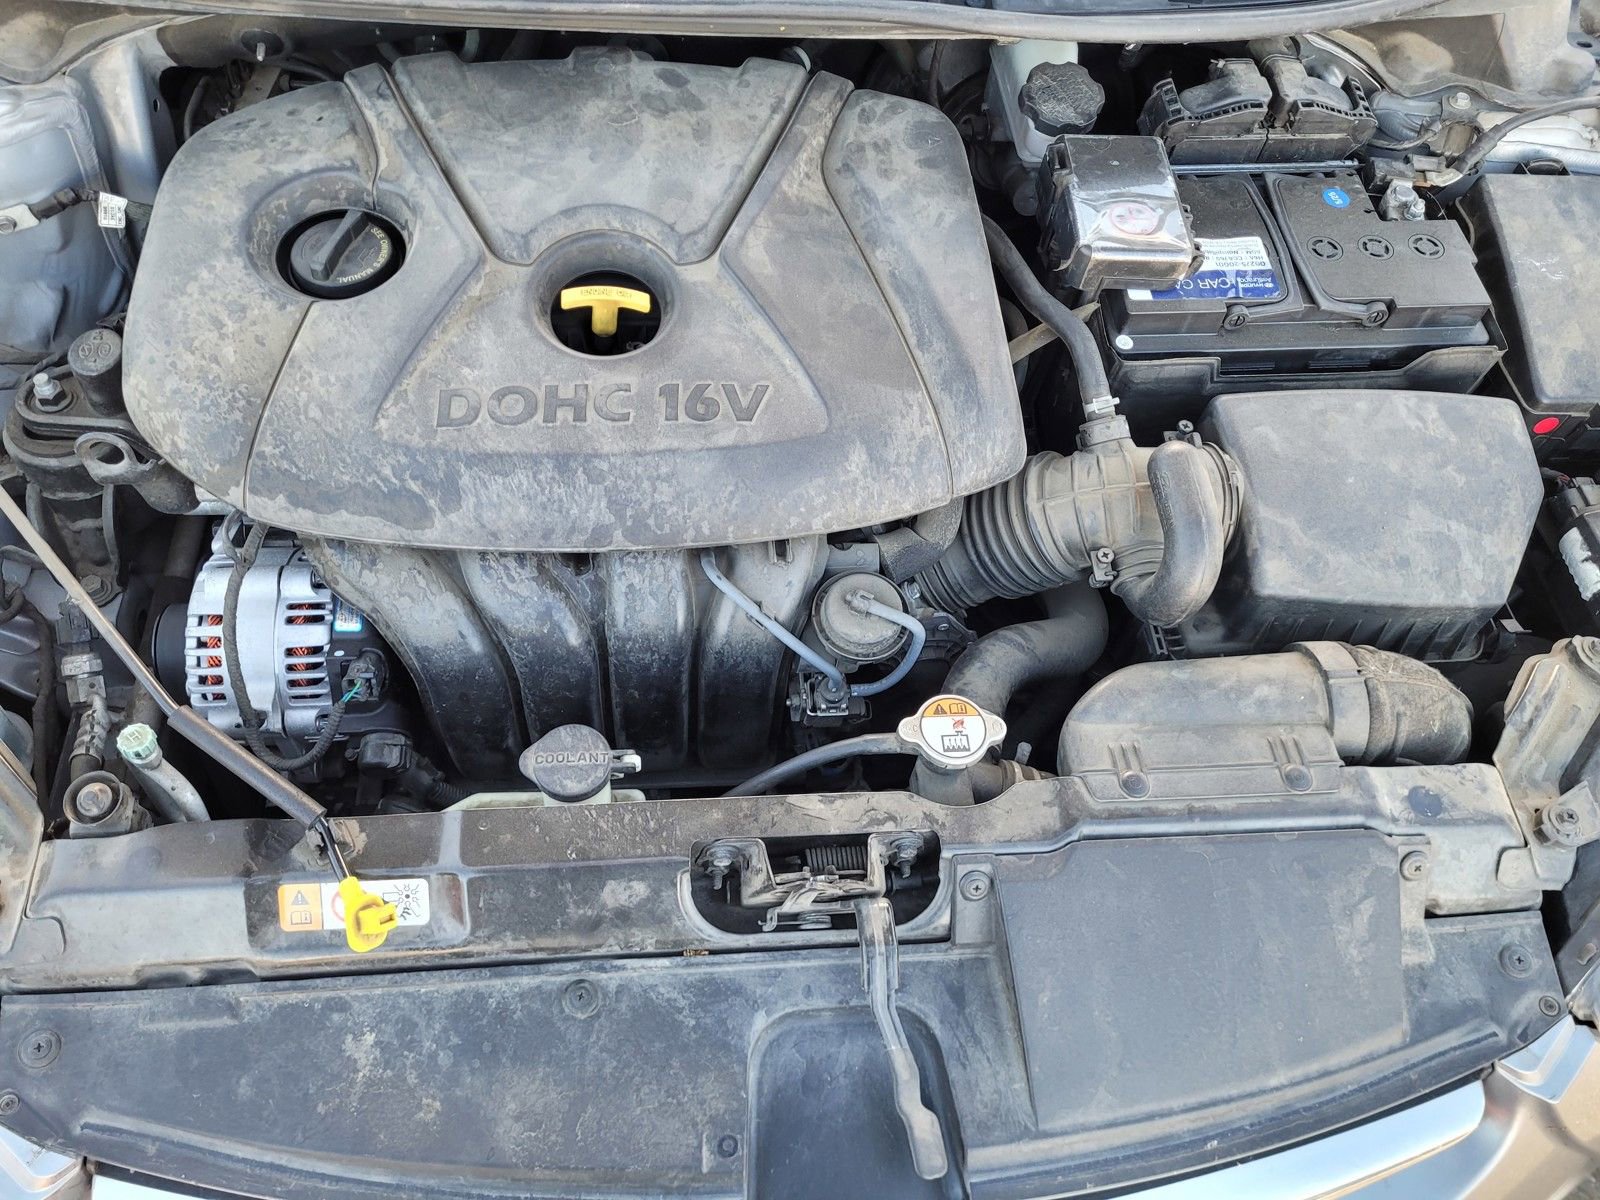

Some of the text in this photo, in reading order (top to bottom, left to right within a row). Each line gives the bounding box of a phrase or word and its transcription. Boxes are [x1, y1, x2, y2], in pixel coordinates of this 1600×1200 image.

[336, 227, 390, 284] SEE OWNER'S MANUAL
[1198, 278, 1231, 289] CAR
[435, 382, 771, 428] DOHC 16V
[126, 729, 142, 743] H
[535, 752, 609, 765] COOLANT
